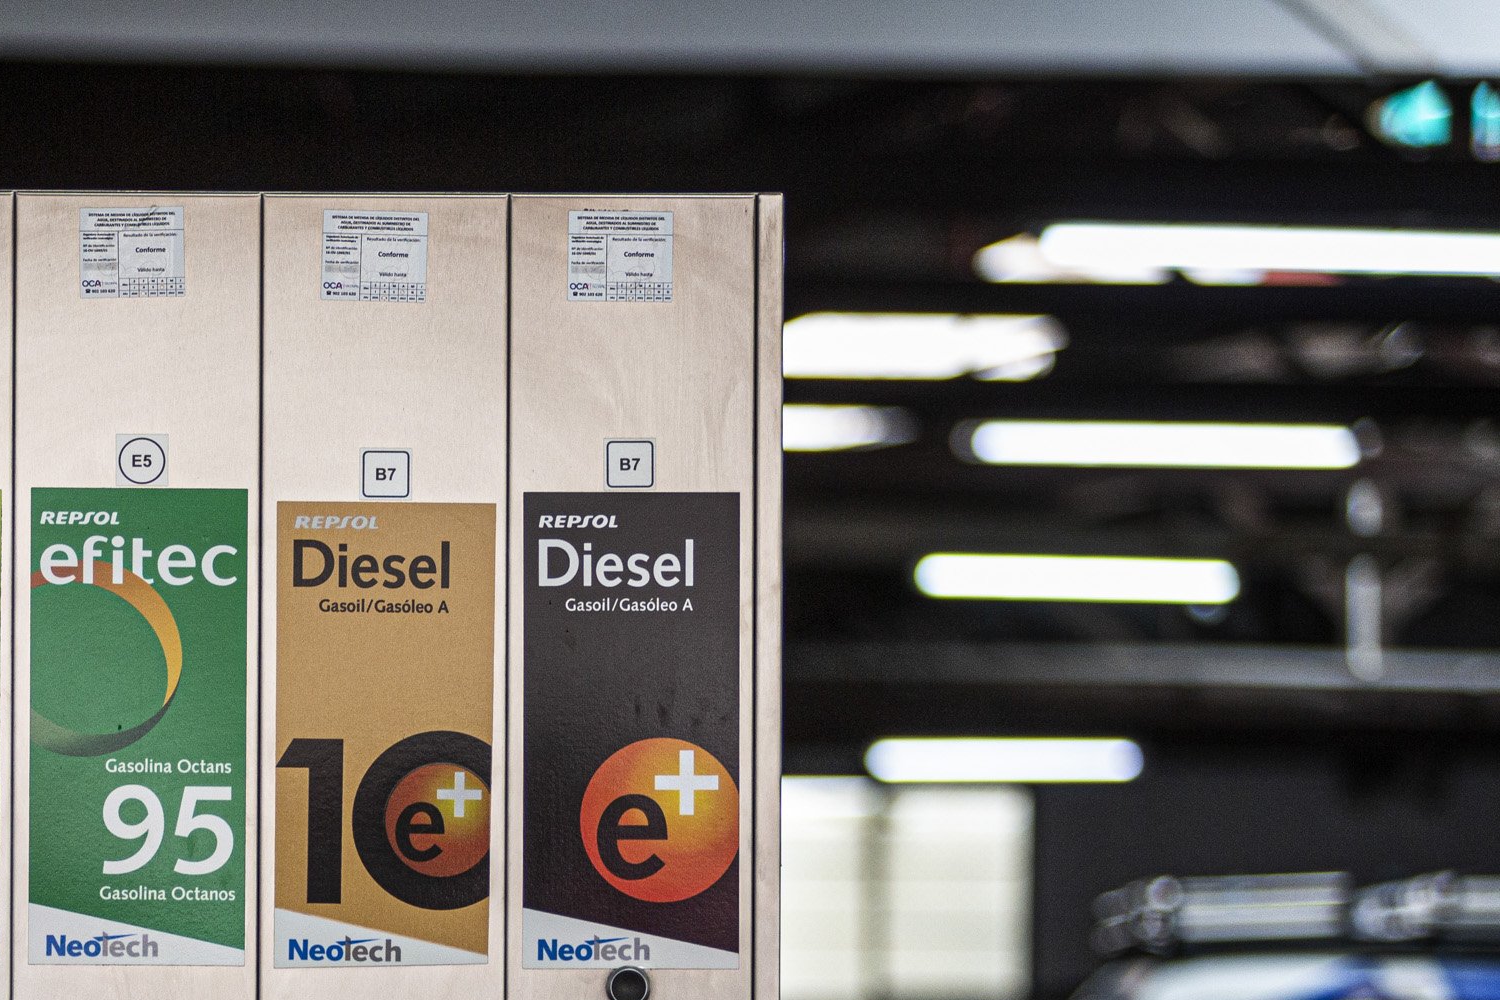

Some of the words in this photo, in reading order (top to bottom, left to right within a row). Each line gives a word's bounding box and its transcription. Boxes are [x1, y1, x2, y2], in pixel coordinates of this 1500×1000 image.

[132, 454, 152, 468] E5
[620, 458, 640, 471] B7
[375, 468, 396, 480] B7
[40, 511, 119, 525] REPSOL
[295, 515, 379, 530] REPSOL
[539, 515, 618, 528] REPSOL
[40, 536, 238, 586] efitec
[293, 540, 450, 589] Diesel
[538, 539, 694, 587] Diesel
[319, 599, 433, 614] Gasoil/Gasóleo
[438, 601, 449, 614] A
[566, 598, 677, 613] Gasoil/Gasóleo
[682, 599, 693, 611] A
[105, 758, 172, 774] Gasolina
[177, 758, 232, 774] Octans
[102, 784, 234, 875] 95
[99, 886, 166, 901] Gasolina
[172, 886, 236, 901] Octanos
[45, 932, 158, 958] NeoTech
[288, 935, 401, 962] NeoTech
[537, 934, 650, 961] NeoTech
